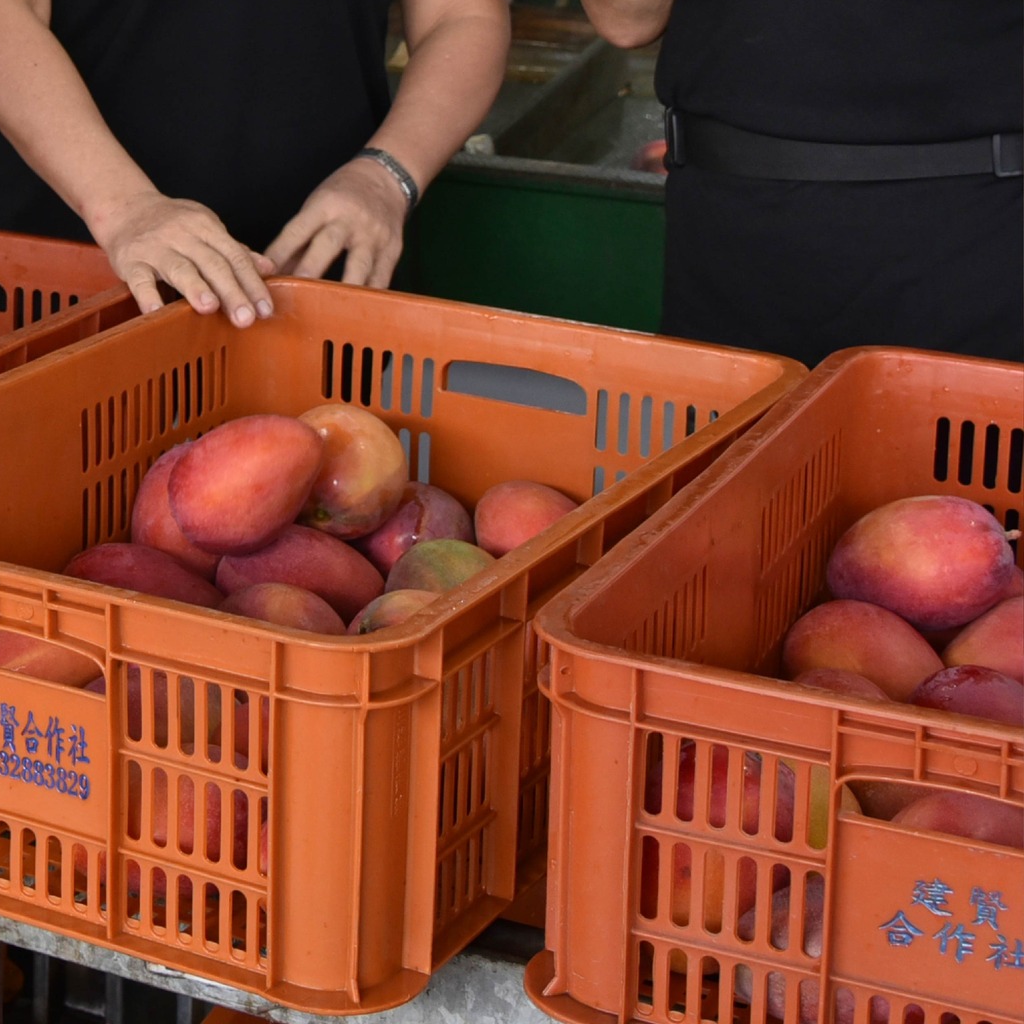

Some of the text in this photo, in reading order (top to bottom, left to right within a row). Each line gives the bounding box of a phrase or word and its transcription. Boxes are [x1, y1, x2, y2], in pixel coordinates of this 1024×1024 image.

[910, 877, 1010, 931] 建賢
[878, 910, 1024, 970] 合作社
